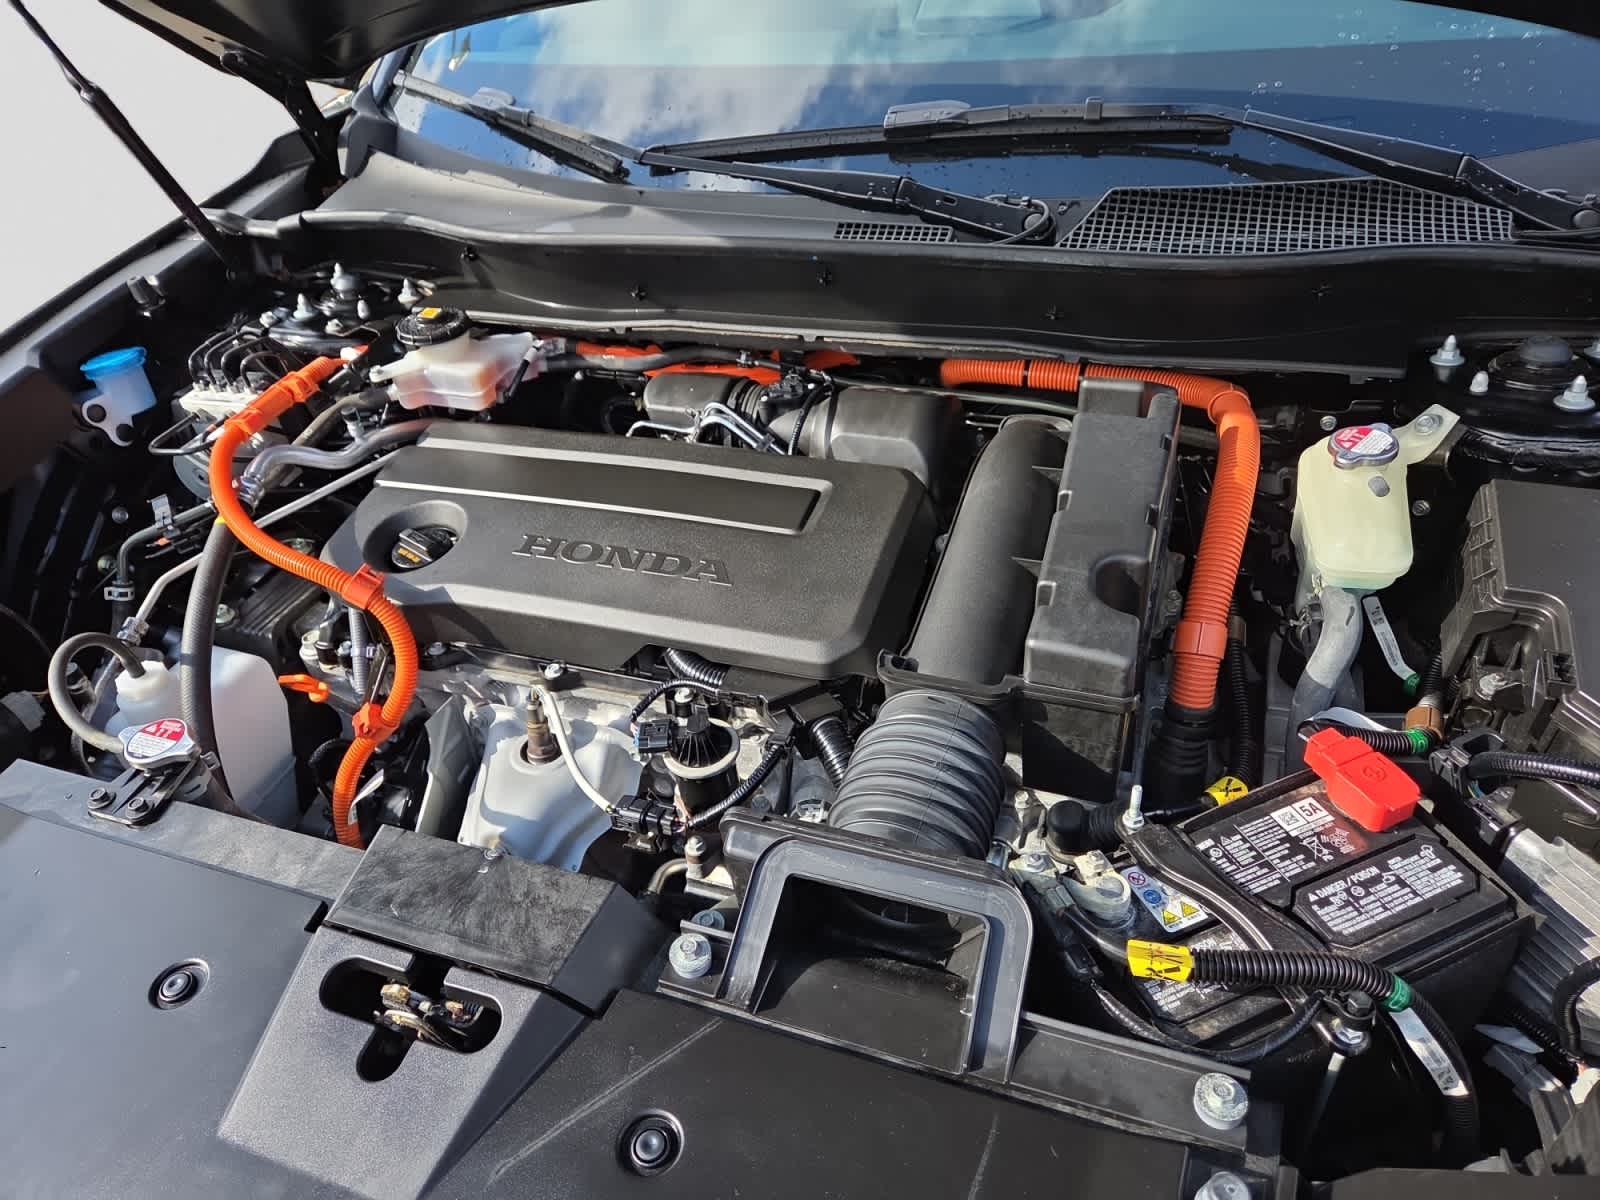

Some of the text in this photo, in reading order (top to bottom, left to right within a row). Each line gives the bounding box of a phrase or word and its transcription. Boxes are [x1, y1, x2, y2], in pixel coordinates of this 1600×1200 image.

[511, 533, 735, 587] HONDA
[1299, 802, 1323, 817] 5A
[1315, 879, 1347, 898] DANGER
[1352, 866, 1380, 884] POISON
